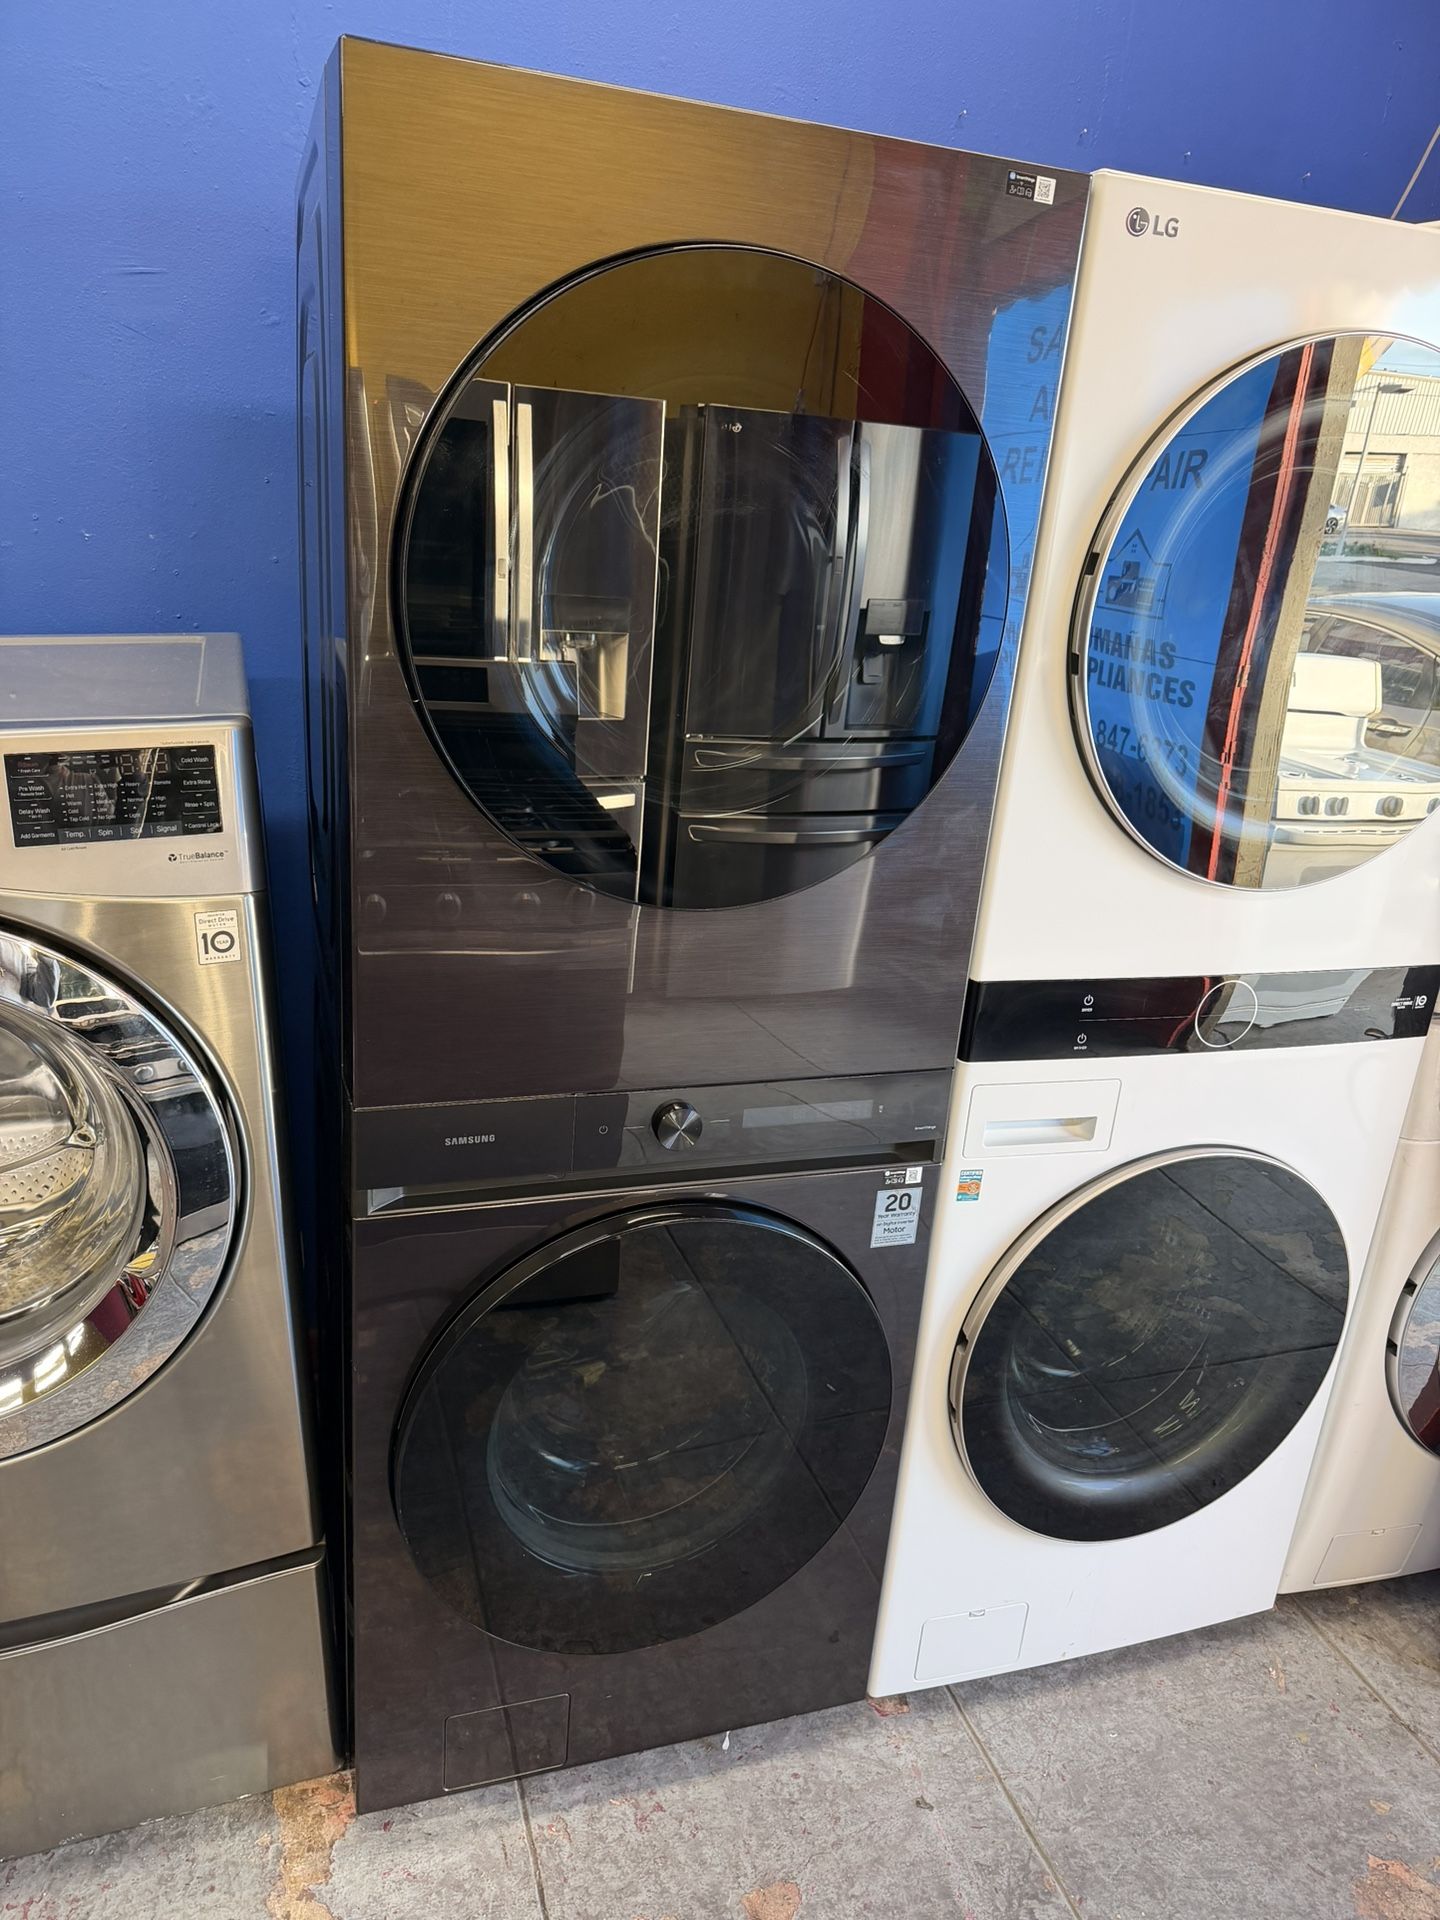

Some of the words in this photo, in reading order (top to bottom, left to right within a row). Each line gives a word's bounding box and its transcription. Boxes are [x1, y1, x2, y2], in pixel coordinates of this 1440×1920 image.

[1152, 215, 1180, 238] LG
[156, 824, 177, 832] Signal
[201, 931, 235, 955] 10
[444, 1134, 496, 1146] SAMSUNG
[884, 1192, 912, 1212] 20
[883, 1226, 906, 1234] Motor
